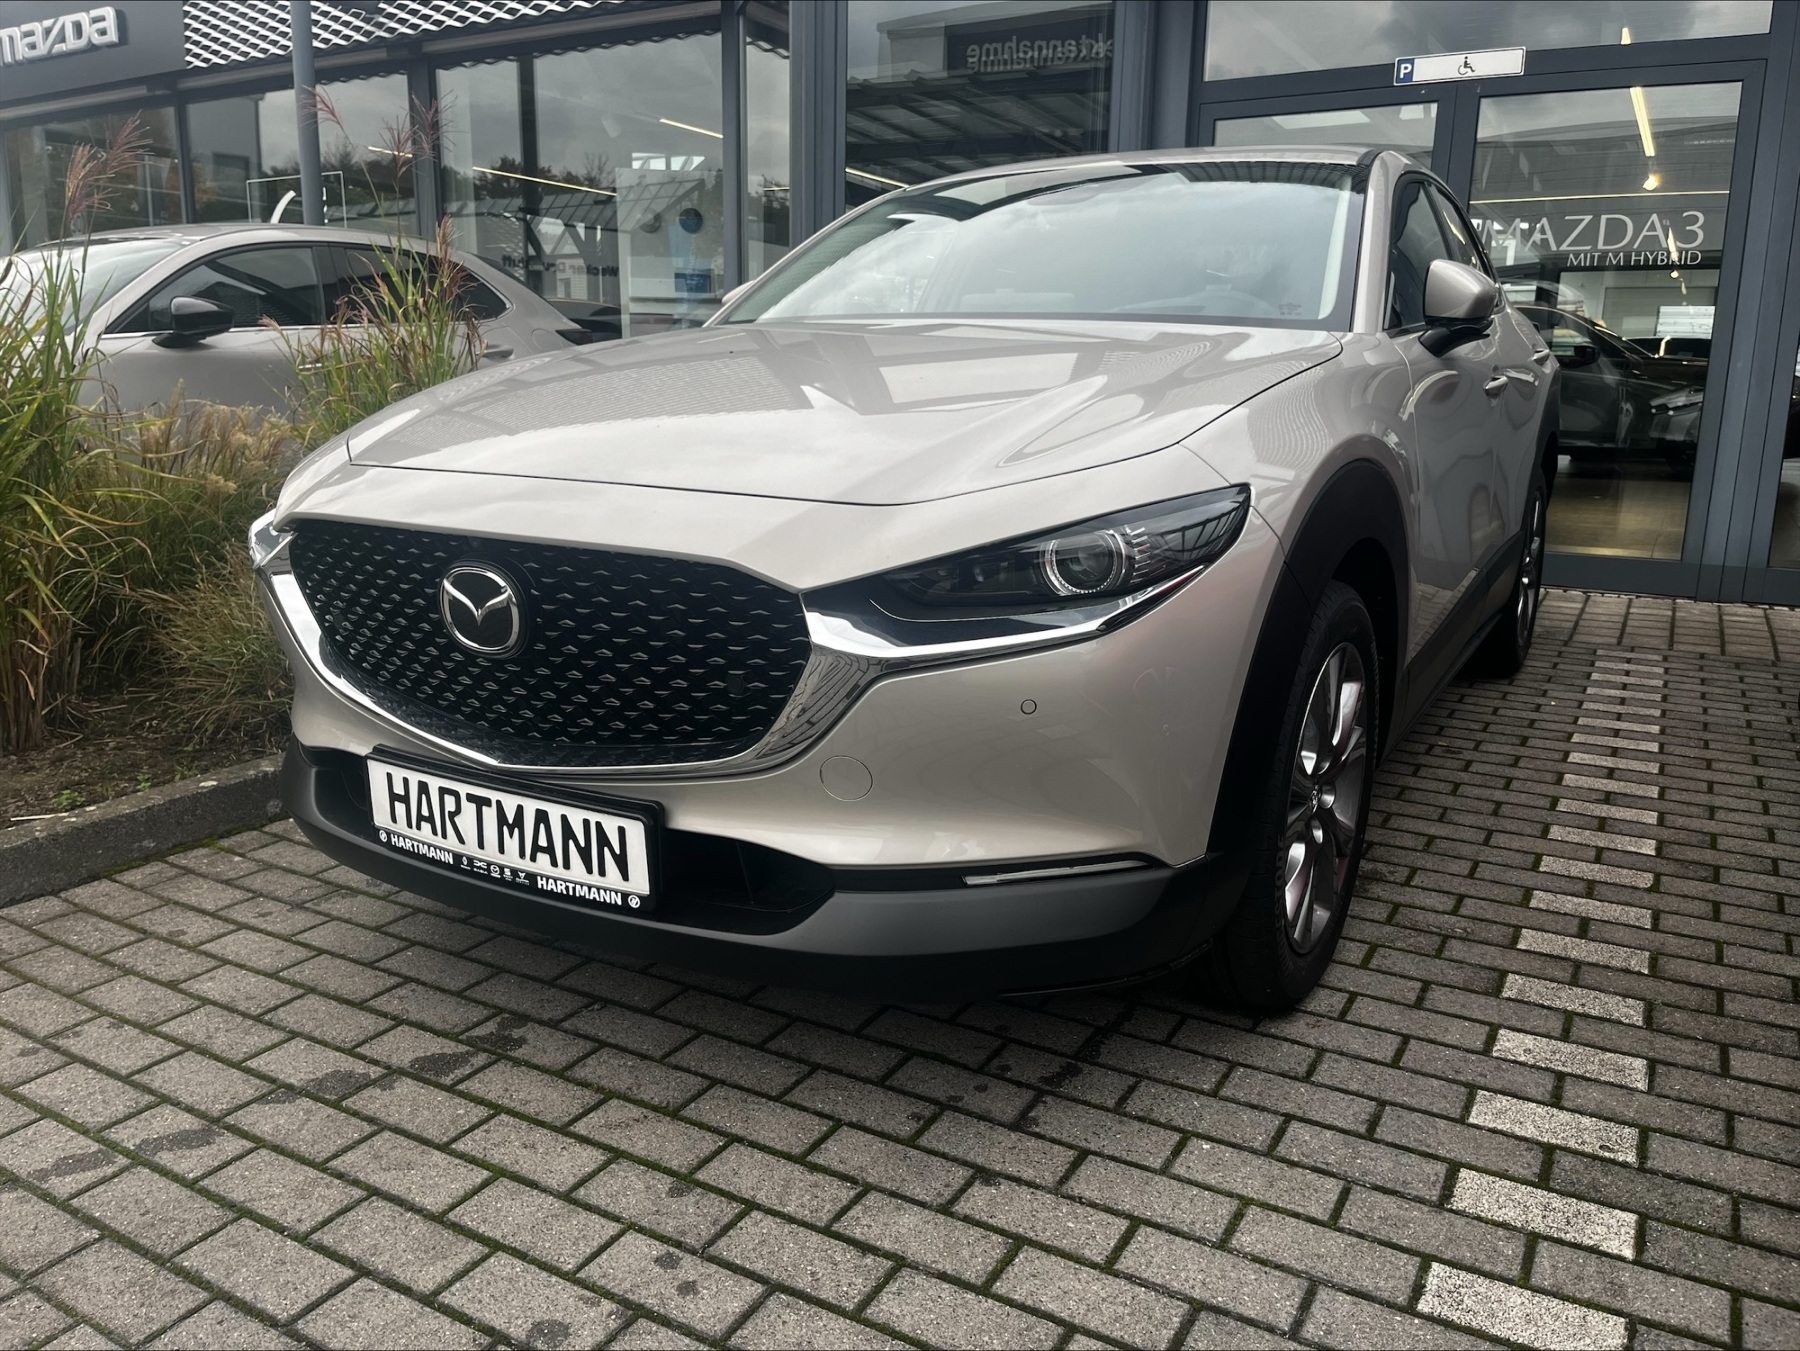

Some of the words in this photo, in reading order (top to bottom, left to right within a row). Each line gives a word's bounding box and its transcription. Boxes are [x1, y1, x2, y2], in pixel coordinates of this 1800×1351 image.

[1400, 63, 1412, 79] P
[1566, 252, 1602, 267] MIT
[1606, 252, 1625, 267] M
[1630, 250, 1702, 266] HYBRID
[386, 771, 630, 882] HARTMANN
[390, 833, 454, 865] HARTMANN
[536, 875, 622, 906] HARTMANN
